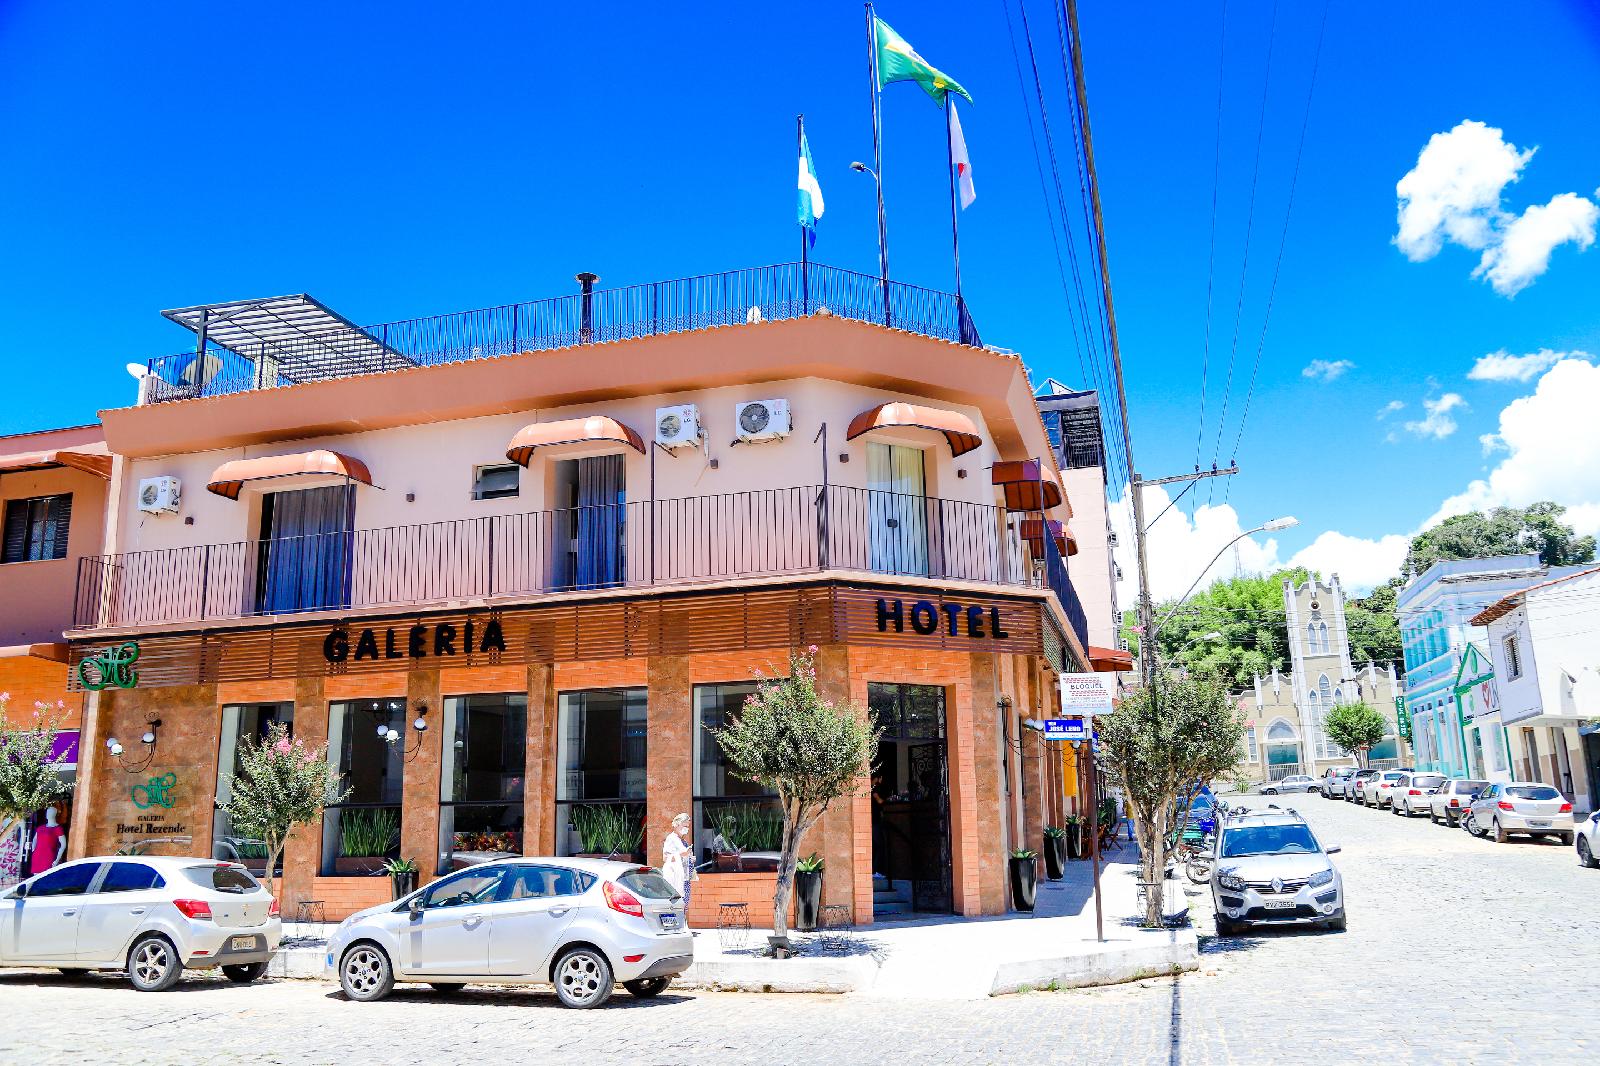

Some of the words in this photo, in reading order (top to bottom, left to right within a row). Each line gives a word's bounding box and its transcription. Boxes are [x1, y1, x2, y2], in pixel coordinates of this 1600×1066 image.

[876, 598, 1009, 638] HOTEL
[323, 619, 506, 663] GALERIA
[116, 823, 143, 834] Hotel
[146, 822, 186, 834] Rezende
